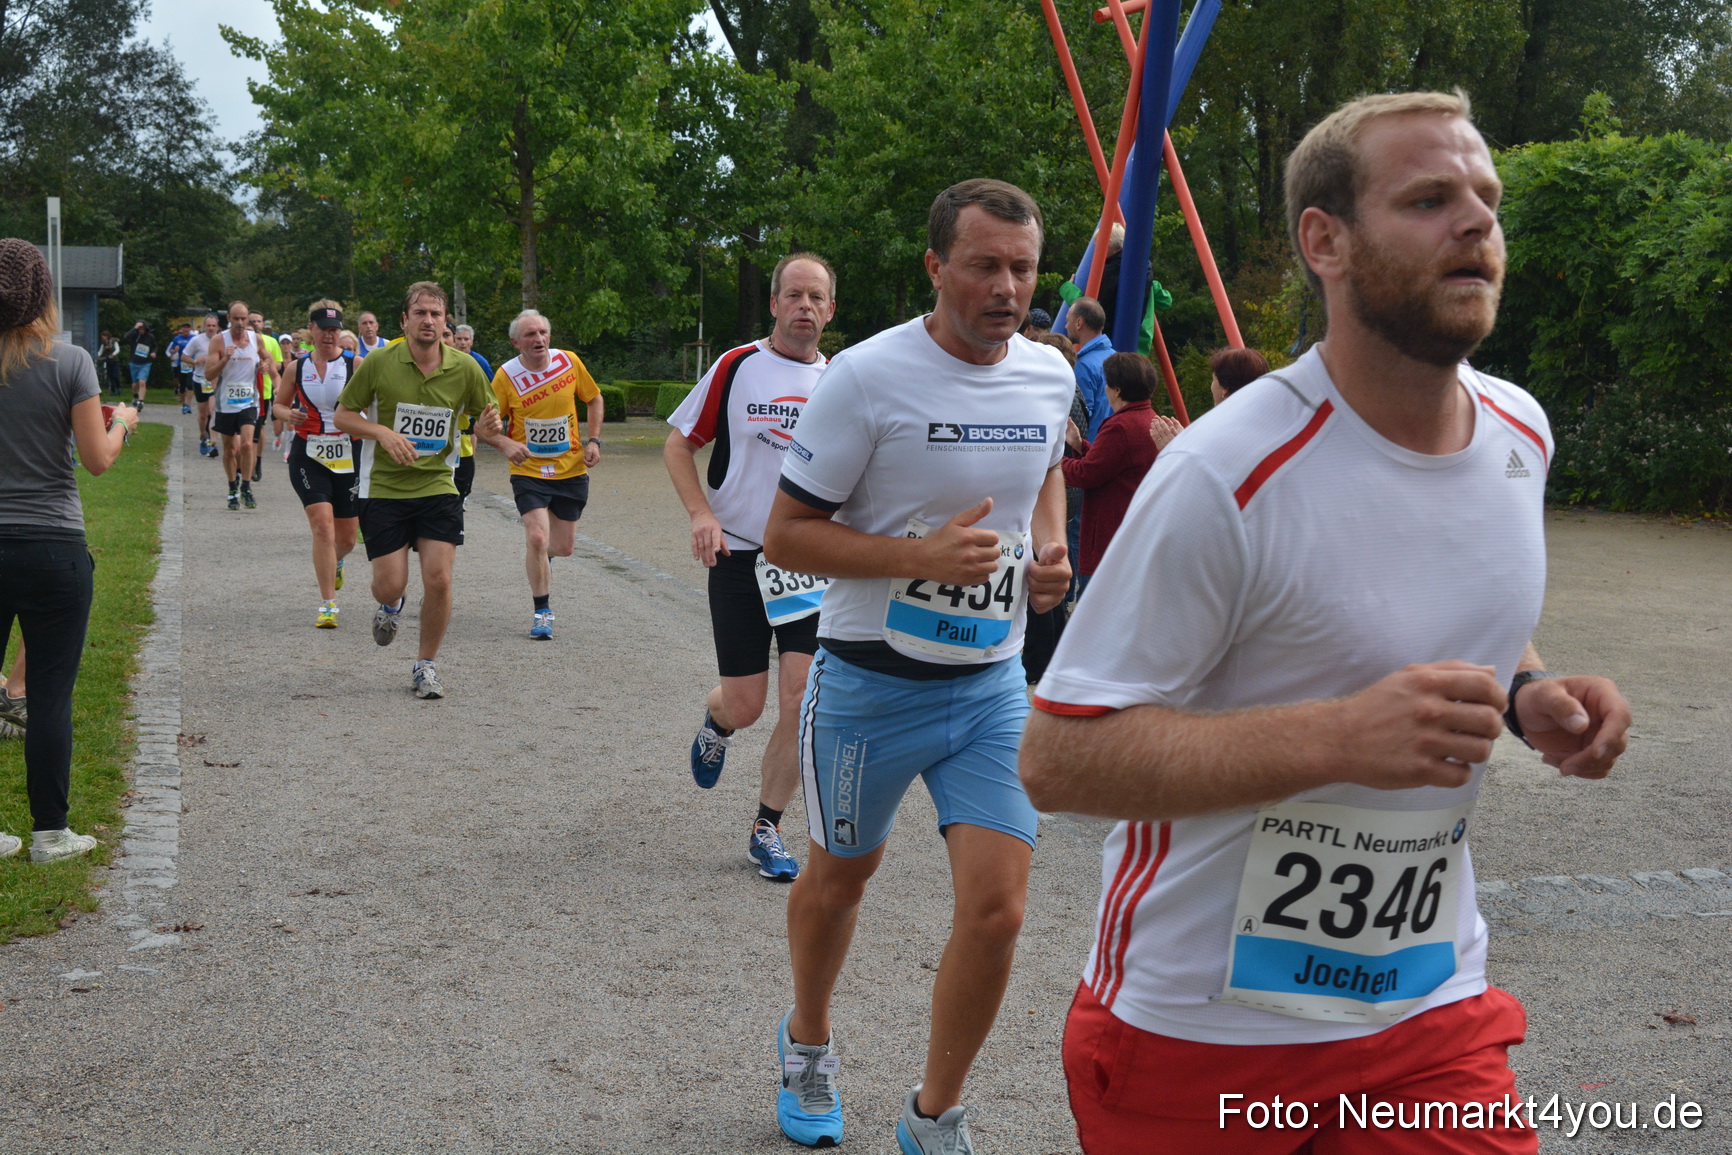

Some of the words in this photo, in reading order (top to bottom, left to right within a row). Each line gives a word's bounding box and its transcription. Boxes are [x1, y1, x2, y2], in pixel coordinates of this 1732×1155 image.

[521, 389, 550, 409] MAX
[551, 373, 577, 394] BÖGL
[746, 403, 804, 419] GERHA
[747, 415, 782, 423] Autohaus
[399, 415, 446, 438] 2696
[529, 426, 566, 443] 2228
[968, 427, 1045, 440] BÜSCHEL
[756, 432, 770, 445] Das
[316, 443, 344, 460] 280
[926, 444, 1001, 453] FEINSCHNEIDTECHNIK
[894, 590, 902, 601] C
[935, 619, 978, 643] Paul
[1261, 817, 1347, 849] PARTL
[1353, 830, 1449, 854] Neumarkt
[1262, 852, 1447, 940] 2346
[1243, 918, 1254, 933] A
[1294, 954, 1399, 997] Jochen
